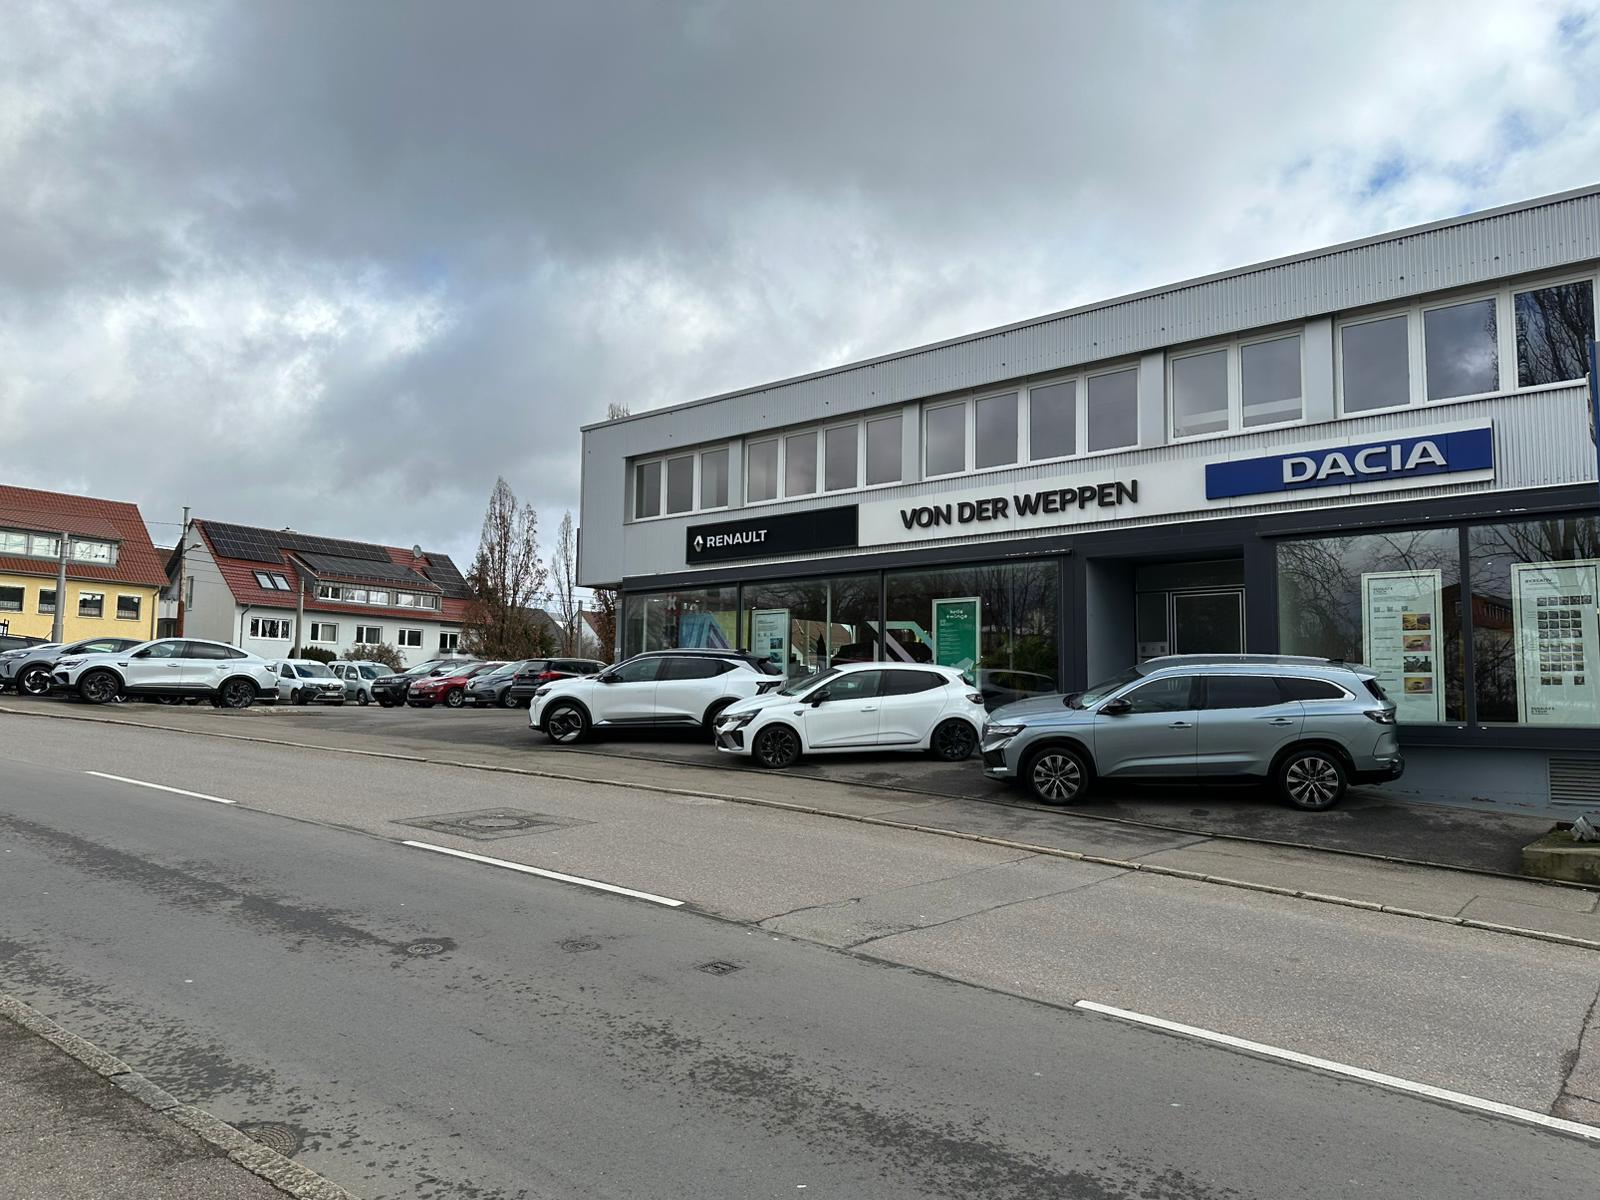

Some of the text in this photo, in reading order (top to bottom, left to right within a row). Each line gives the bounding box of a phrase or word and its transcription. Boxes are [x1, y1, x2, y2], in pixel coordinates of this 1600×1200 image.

[1283, 440, 1447, 483] DACIA
[900, 479, 1138, 530] VON DER WEPPEN
[706, 529, 767, 548] RENAULT
